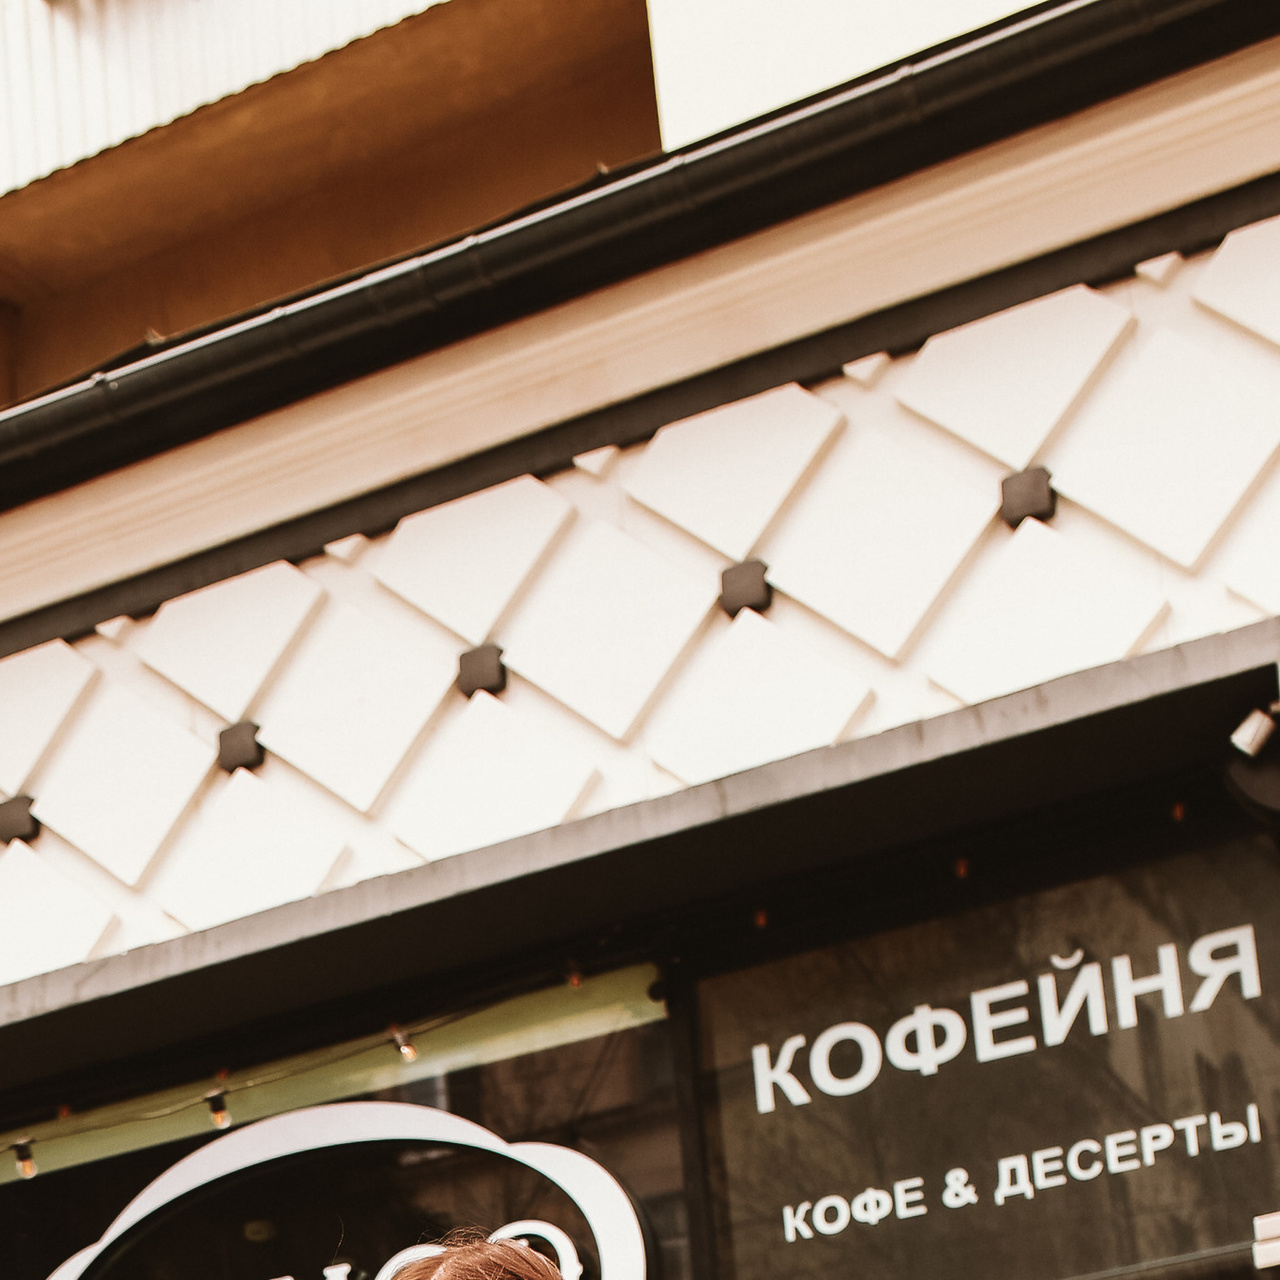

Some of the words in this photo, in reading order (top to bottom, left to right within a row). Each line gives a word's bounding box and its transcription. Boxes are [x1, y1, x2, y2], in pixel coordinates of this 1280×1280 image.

[751, 923, 1262, 1115] КОФЕЙНЯ
[781, 1176, 928, 1243] КОФЕ
[941, 1167, 979, 1209] &
[993, 1103, 1262, 1206] ДЕСЕРТЫ
